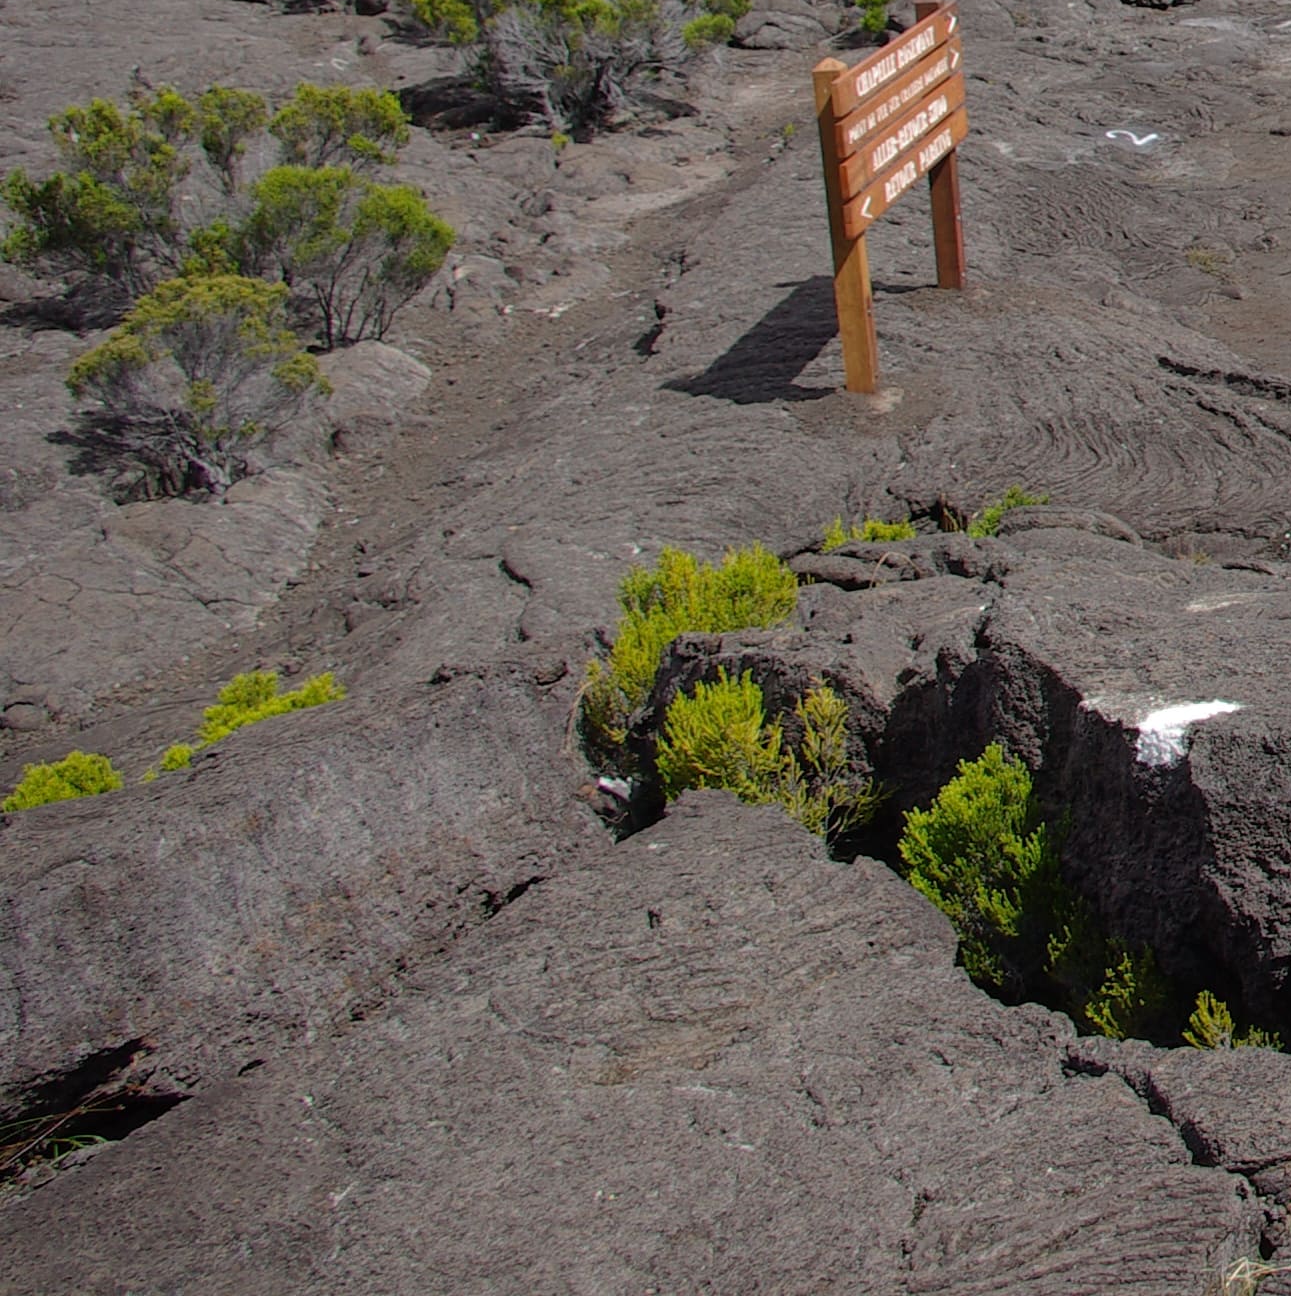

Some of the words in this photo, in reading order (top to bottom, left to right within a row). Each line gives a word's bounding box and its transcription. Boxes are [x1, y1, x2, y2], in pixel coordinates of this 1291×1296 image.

[856, 53, 897, 96] CHAPELLE
[885, 160, 917, 202] RETOUR
[918, 128, 952, 172] PARKING
